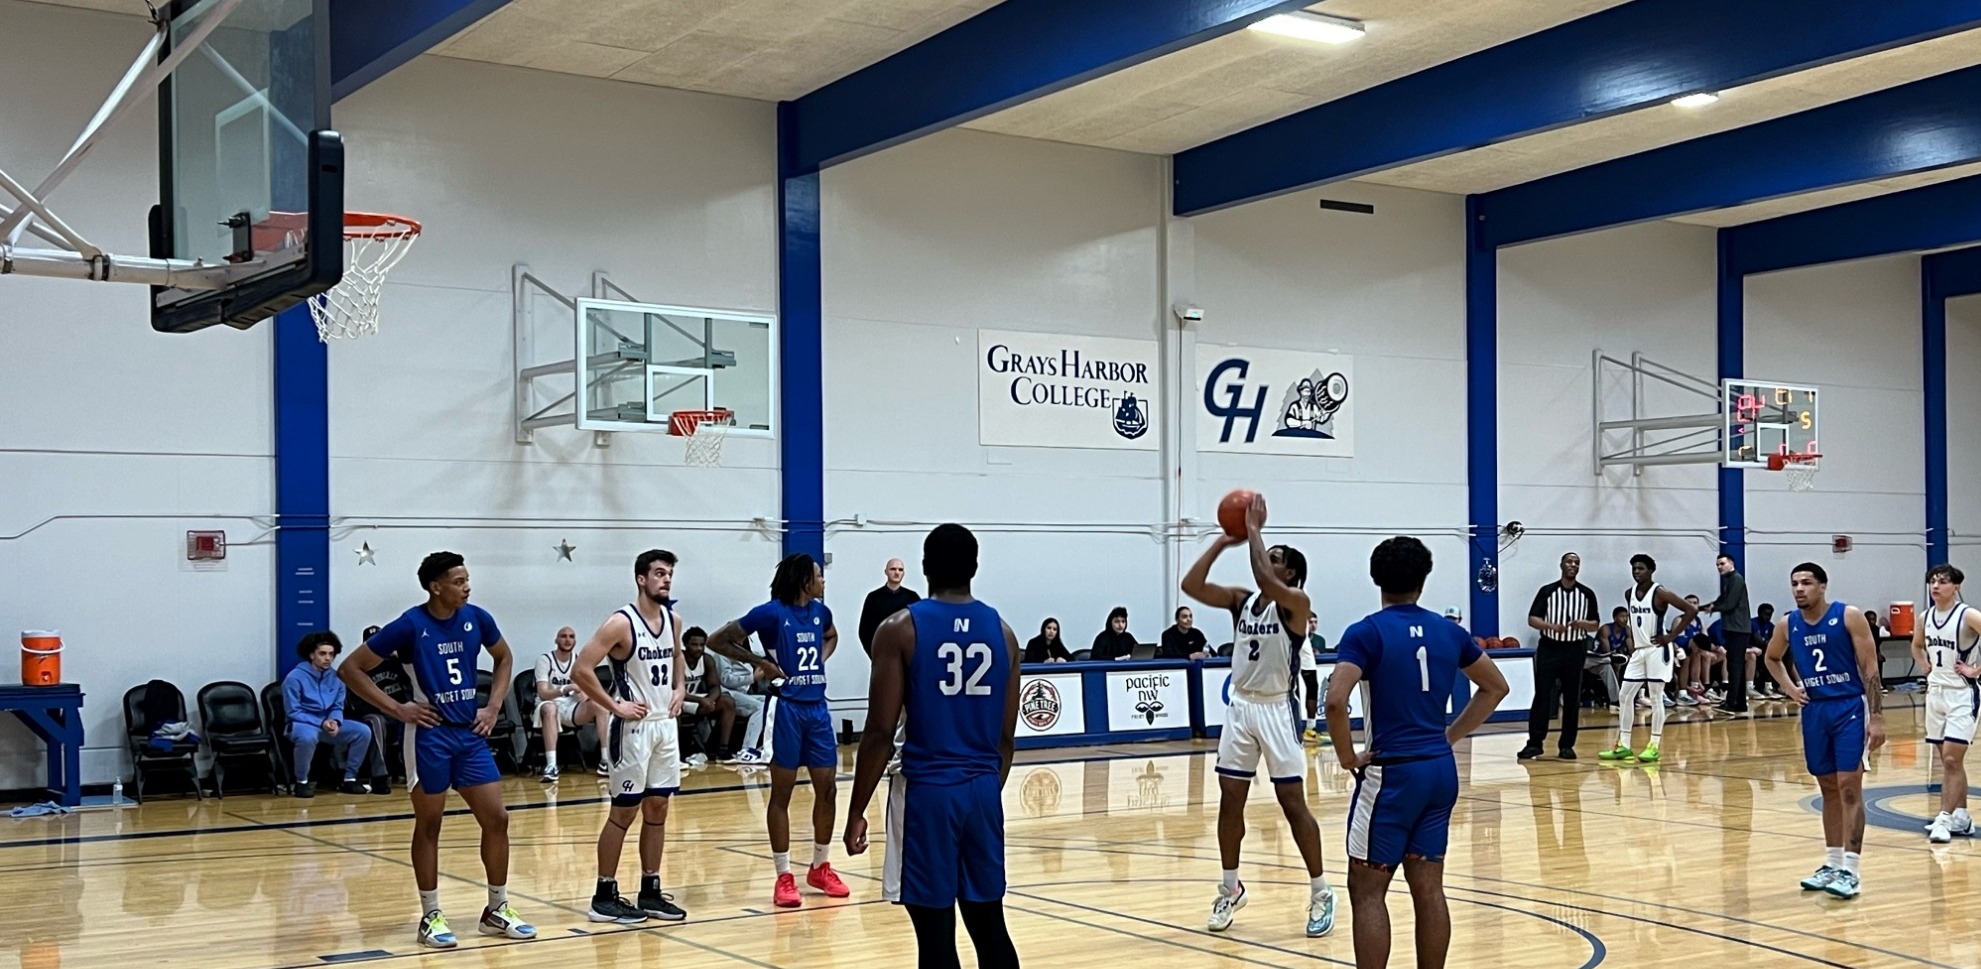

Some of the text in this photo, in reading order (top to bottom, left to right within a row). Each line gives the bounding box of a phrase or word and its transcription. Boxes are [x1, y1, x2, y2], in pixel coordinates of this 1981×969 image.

[1204, 358, 1270, 443] GH
[953, 618, 970, 633] N
[1409, 625, 1424, 638] N
[437, 641, 464, 655] SOUTH
[1804, 633, 1827, 647] SOUTH
[797, 646, 819, 671] 22
[1248, 640, 1260, 661] 2
[1812, 648, 1828, 672] 2
[1936, 650, 1943, 667] 1
[446, 657, 463, 685] 5
[938, 642, 992, 696] 32
[1416, 646, 1430, 692] 1
[1826, 671, 1851, 685] SOUND
[1125, 673, 1171, 693] pacific
